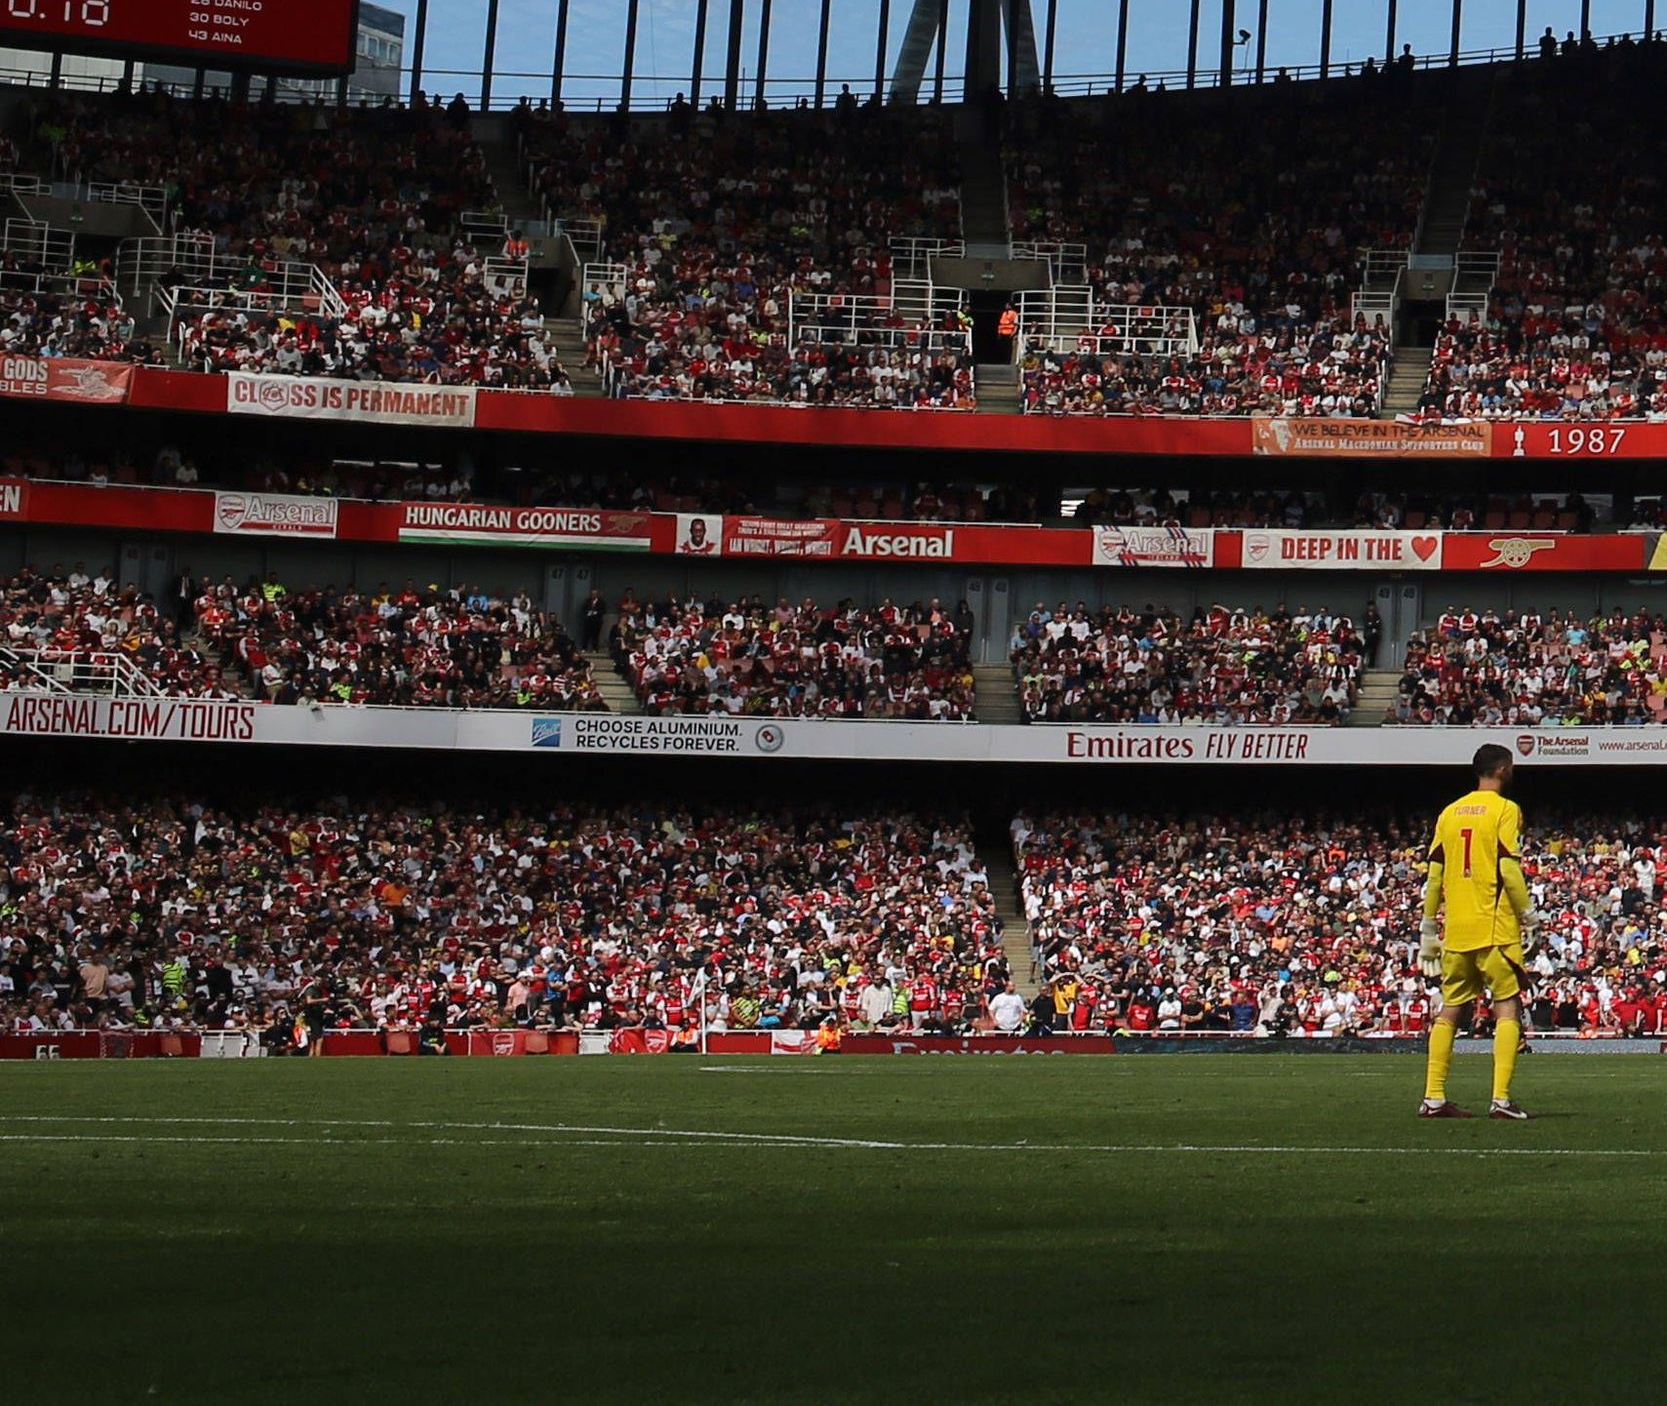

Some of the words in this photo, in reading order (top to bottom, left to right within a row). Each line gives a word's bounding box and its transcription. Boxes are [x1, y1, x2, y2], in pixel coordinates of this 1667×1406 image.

[189, 12, 209, 23] 30
[213, 14, 249, 26] BOLY
[188, 29, 208, 41] 43
[211, 32, 242, 44] AINA
[4, 357, 48, 382] GODS
[321, 386, 342, 409] IS
[346, 388, 470, 416] PERMANENT
[1294, 424, 1317, 436] WE
[1373, 425, 1387, 437] IN
[1391, 425, 1418, 438] THE
[1422, 425, 1484, 438] ARSENAL
[1547, 427, 1626, 454] 1987
[245, 495, 336, 524] Arsenal
[405, 506, 511, 529] HUNGARIAN
[516, 511, 602, 532] GOONERS
[842, 527, 954, 559] Arsenal
[1126, 532, 1208, 554] Arsenal
[1281, 536, 1332, 561] DEEP
[1336, 537, 1359, 561] IN
[1364, 537, 1403, 561] THE
[551, 568, 564, 579] 47
[576, 568, 590, 580] 47
[6, 696, 255, 741] ARSENAL.COM/TOURS
[574, 719, 643, 734] CHOOSE
[647, 721, 743, 737] ALUMINIUM.
[576, 735, 659, 749] RECYCLES
[662, 737, 740, 751] FOREVER.
[1066, 731, 1193, 758] Emirates
[1205, 732, 1240, 759] FLY
[1242, 732, 1309, 758] BETTER
[1537, 736, 1554, 745] The
[1555, 736, 1589, 745] Arsenal
[1537, 747, 1589, 756] Foundation
[1453, 805, 1487, 817] TURNER
[1460, 828, 1473, 878] 1
